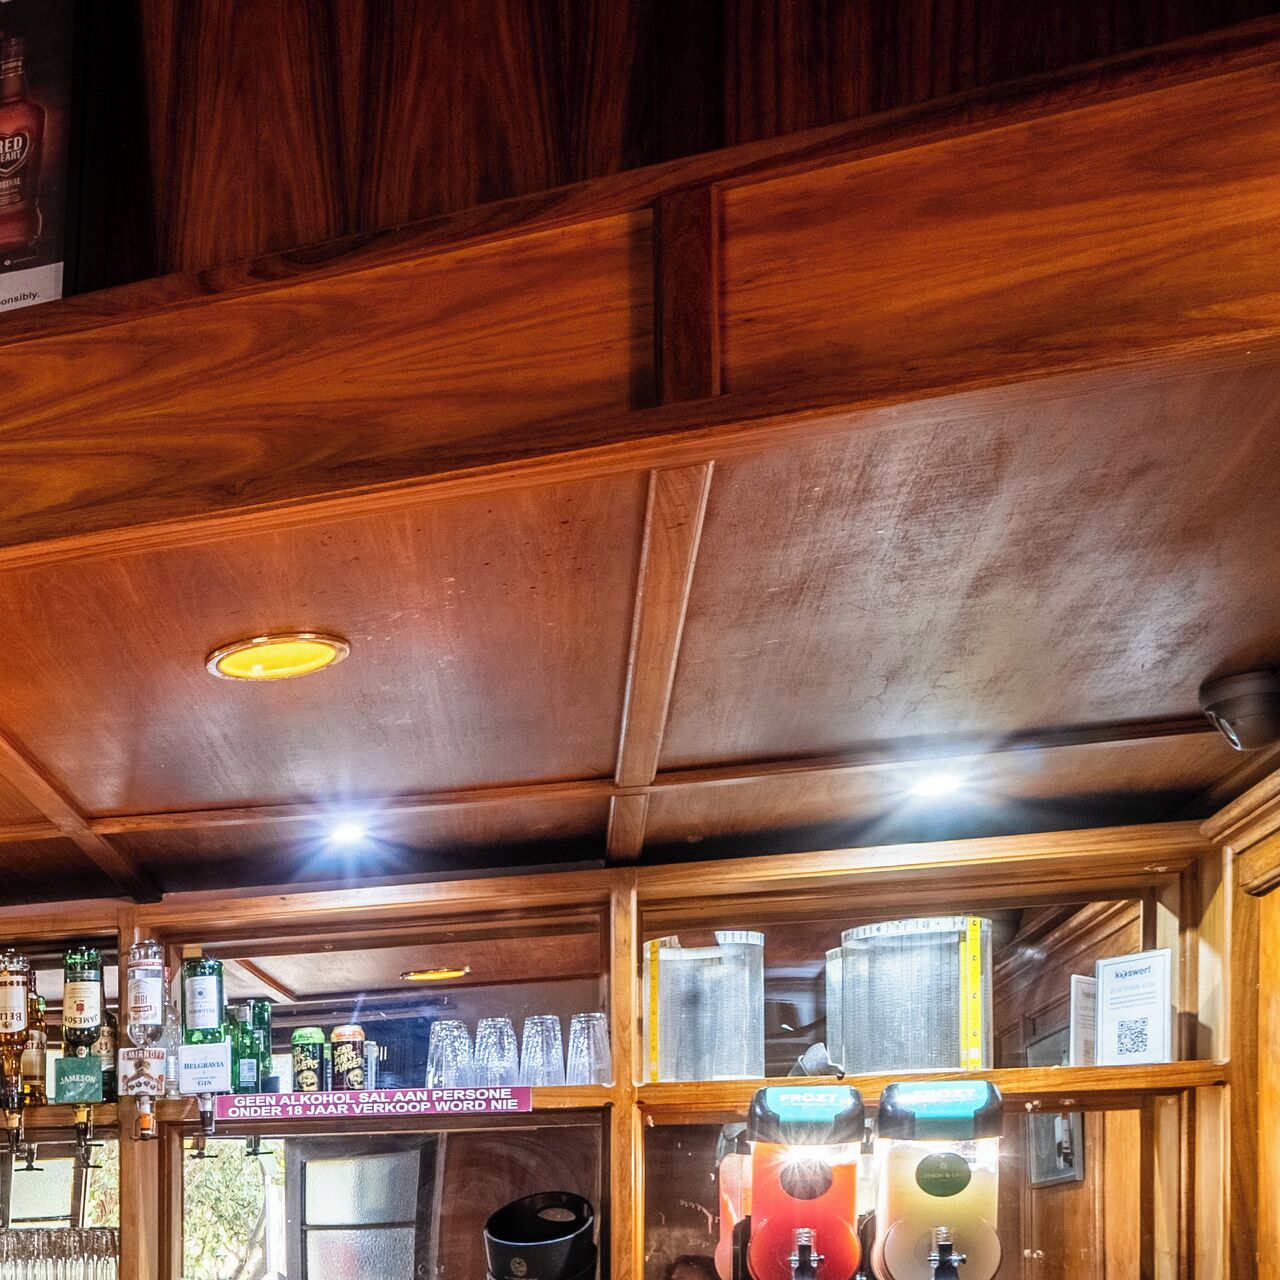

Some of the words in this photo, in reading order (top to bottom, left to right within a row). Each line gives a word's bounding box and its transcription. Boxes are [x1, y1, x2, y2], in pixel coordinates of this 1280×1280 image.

[64, 1014, 98, 1025] JAMESON
[122, 1049, 165, 1060] SMIRNOFF
[184, 1062, 225, 1070] BELGRAVIA
[60, 1074, 97, 1085] JAMESON
[234, 1096, 278, 1107] GEEN
[280, 1093, 355, 1105] ALKOHOL
[359, 1091, 389, 1102] SAL
[392, 1090, 428, 1101] AAN
[432, 1088, 511, 1100] PERSONE
[228, 1106, 282, 1117] ONDER
[286, 1105, 302, 1116] 18
[306, 1104, 348, 1115] JAAR
[354, 1102, 431, 1114] VERKOOP
[435, 1101, 486, 1112] WORD
[491, 1099, 518, 1110] NIE
